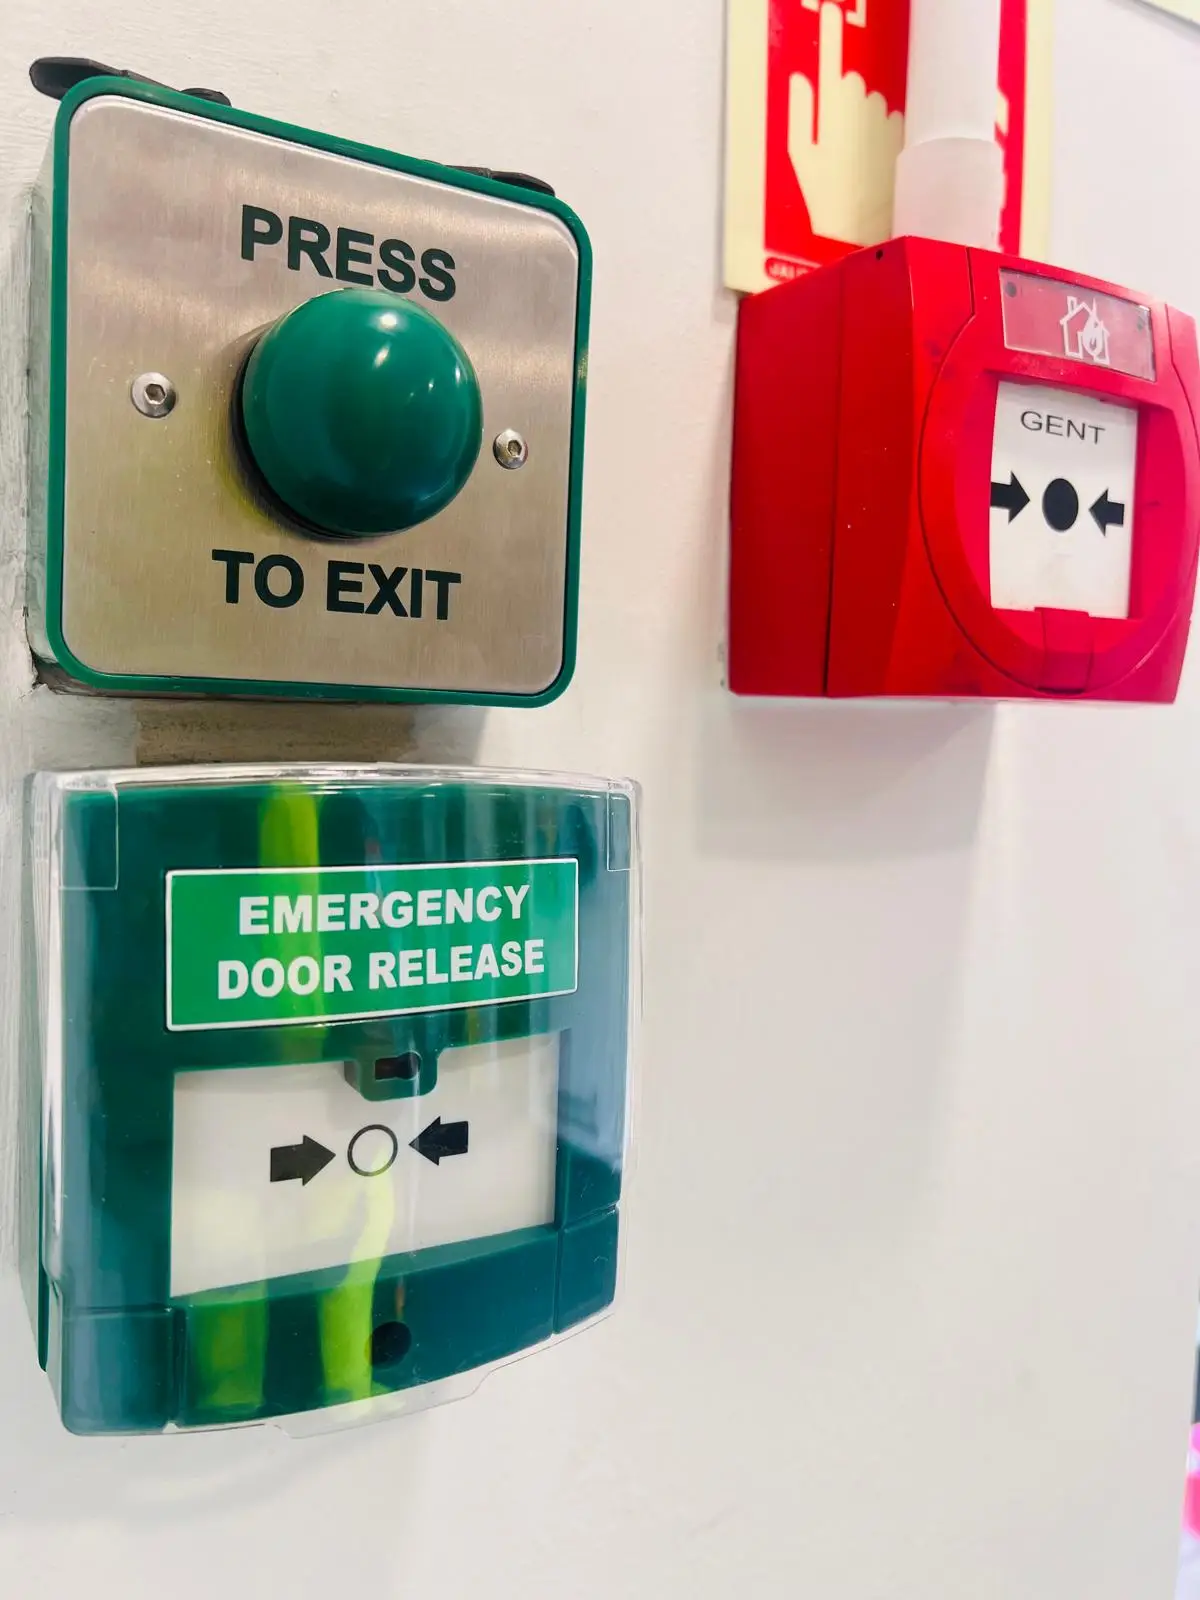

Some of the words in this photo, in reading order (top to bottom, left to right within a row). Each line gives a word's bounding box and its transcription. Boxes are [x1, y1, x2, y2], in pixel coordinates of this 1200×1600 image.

[242, 204, 456, 302] PRESS
[1020, 410, 1105, 445] GENT
[211, 549, 304, 608] TO
[326, 560, 462, 621] EXIT
[239, 884, 530, 935] EMERGENCY
[217, 955, 353, 1000] DOOR
[368, 939, 545, 989] RELEASE
